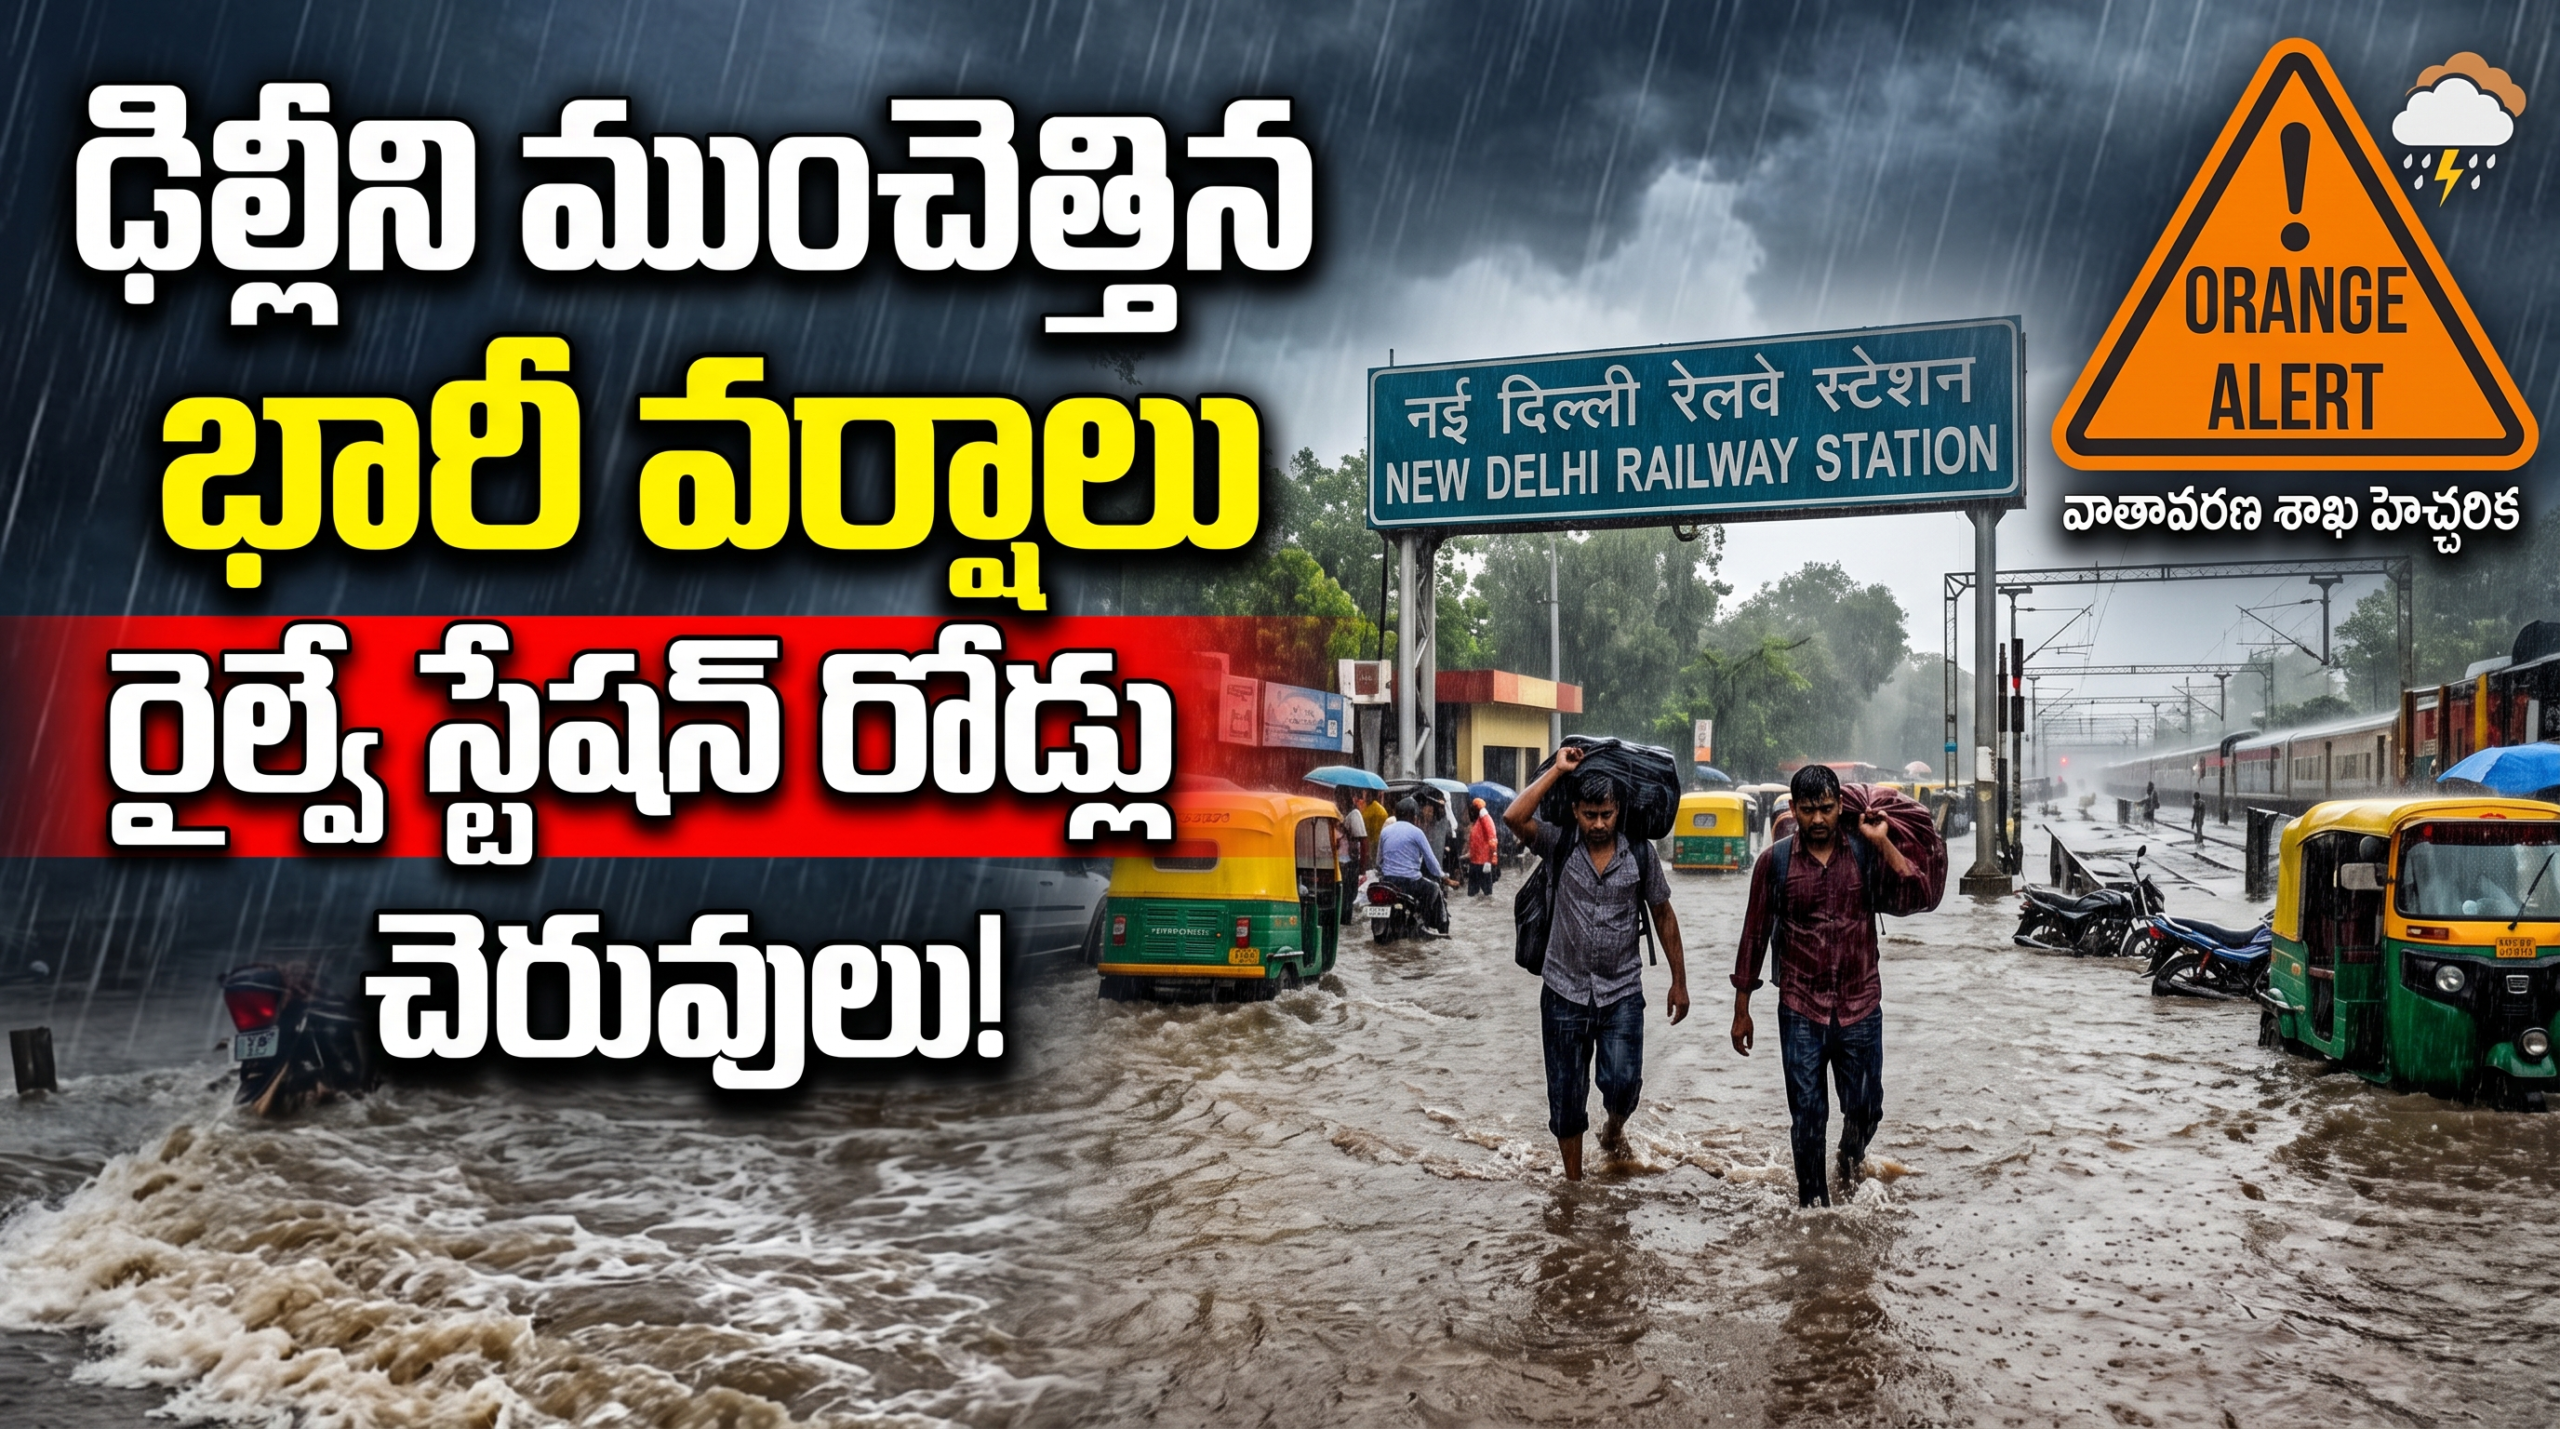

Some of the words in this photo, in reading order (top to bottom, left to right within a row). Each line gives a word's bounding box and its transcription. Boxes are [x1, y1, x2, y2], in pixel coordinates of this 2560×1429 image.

[1404, 376, 1472, 445] नई
[1496, 364, 1641, 435] दिल्ली
[1668, 352, 1785, 423] रेलवे
[1812, 345, 1977, 413] स्टेशन
[1386, 457, 1471, 505] NEW
[1486, 449, 1599, 500] DELHI
[1617, 436, 1799, 493] RAILWAY
[1815, 423, 1998, 482] STATION
